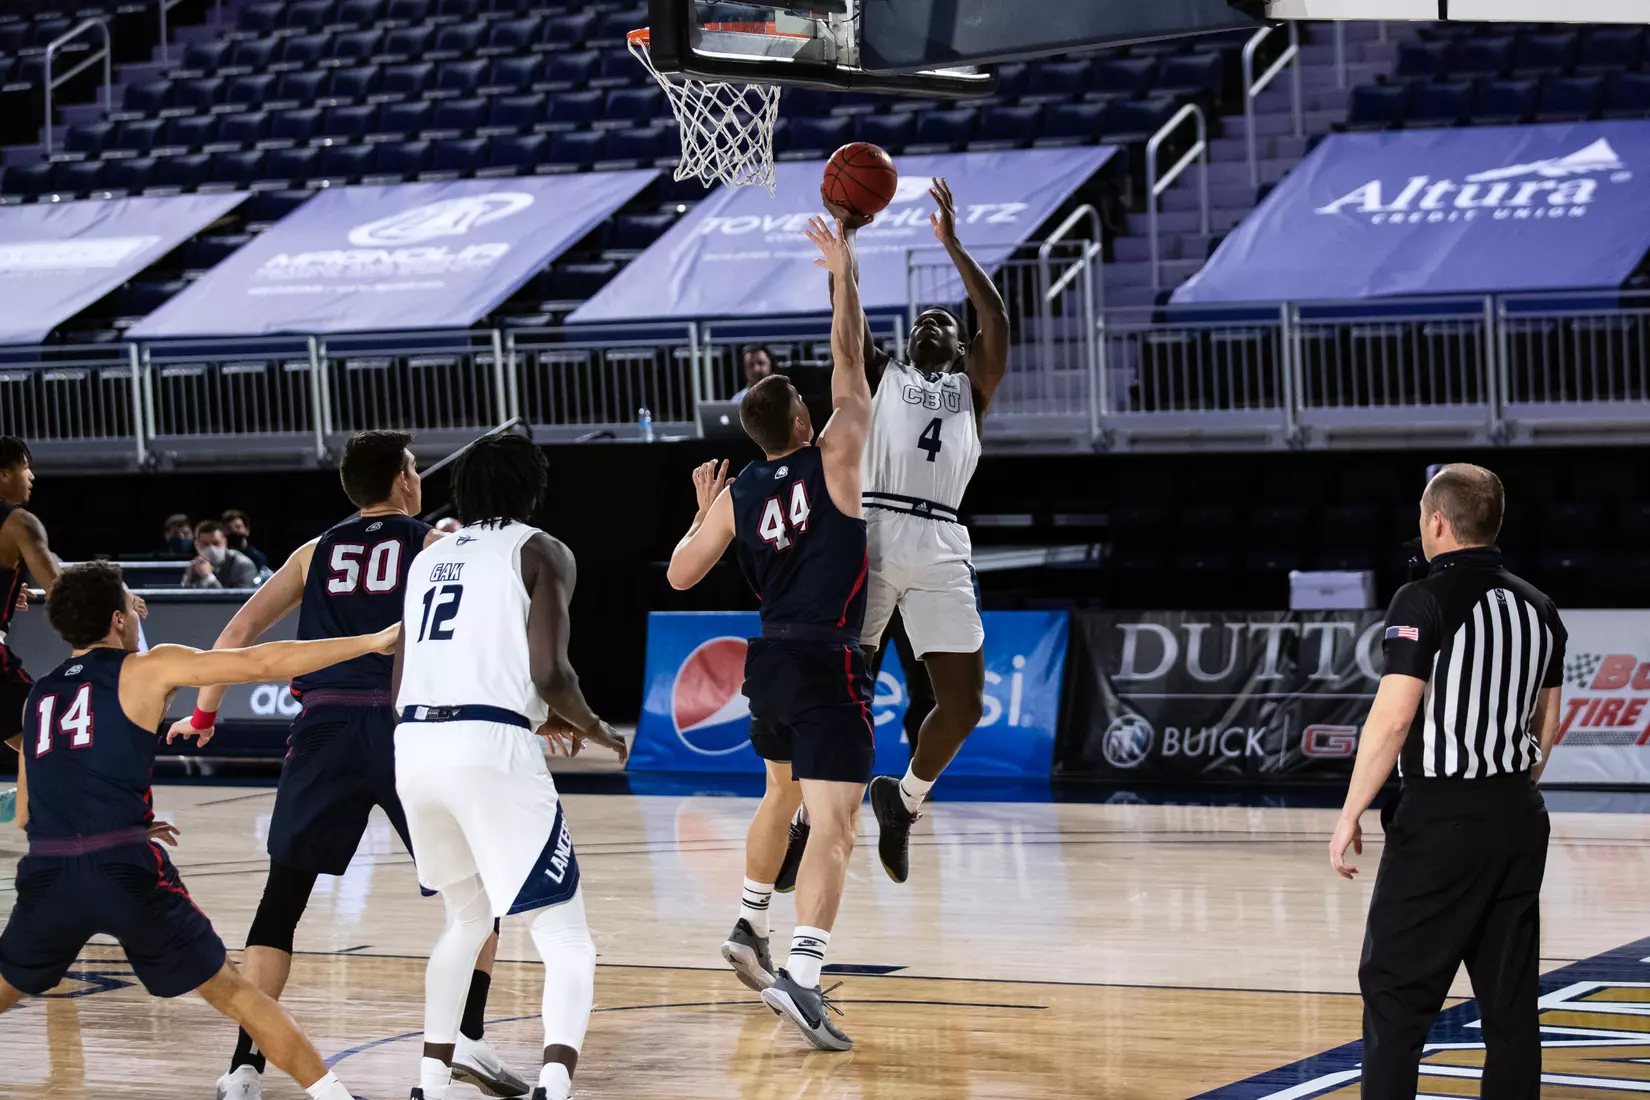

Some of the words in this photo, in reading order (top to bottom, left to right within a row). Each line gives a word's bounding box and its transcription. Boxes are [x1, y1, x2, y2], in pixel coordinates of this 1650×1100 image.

[1315, 174, 1597, 214] Altura
[902, 384, 960, 414] CBU
[917, 417, 943, 463] 4
[757, 479, 812, 553] 44
[326, 537, 404, 597] 50
[430, 562, 465, 582] GAK
[417, 584, 464, 643] 12
[35, 681, 94, 760] 14
[1161, 726, 1267, 757] BUICK
[1552, 697, 1649, 746] TIRE
